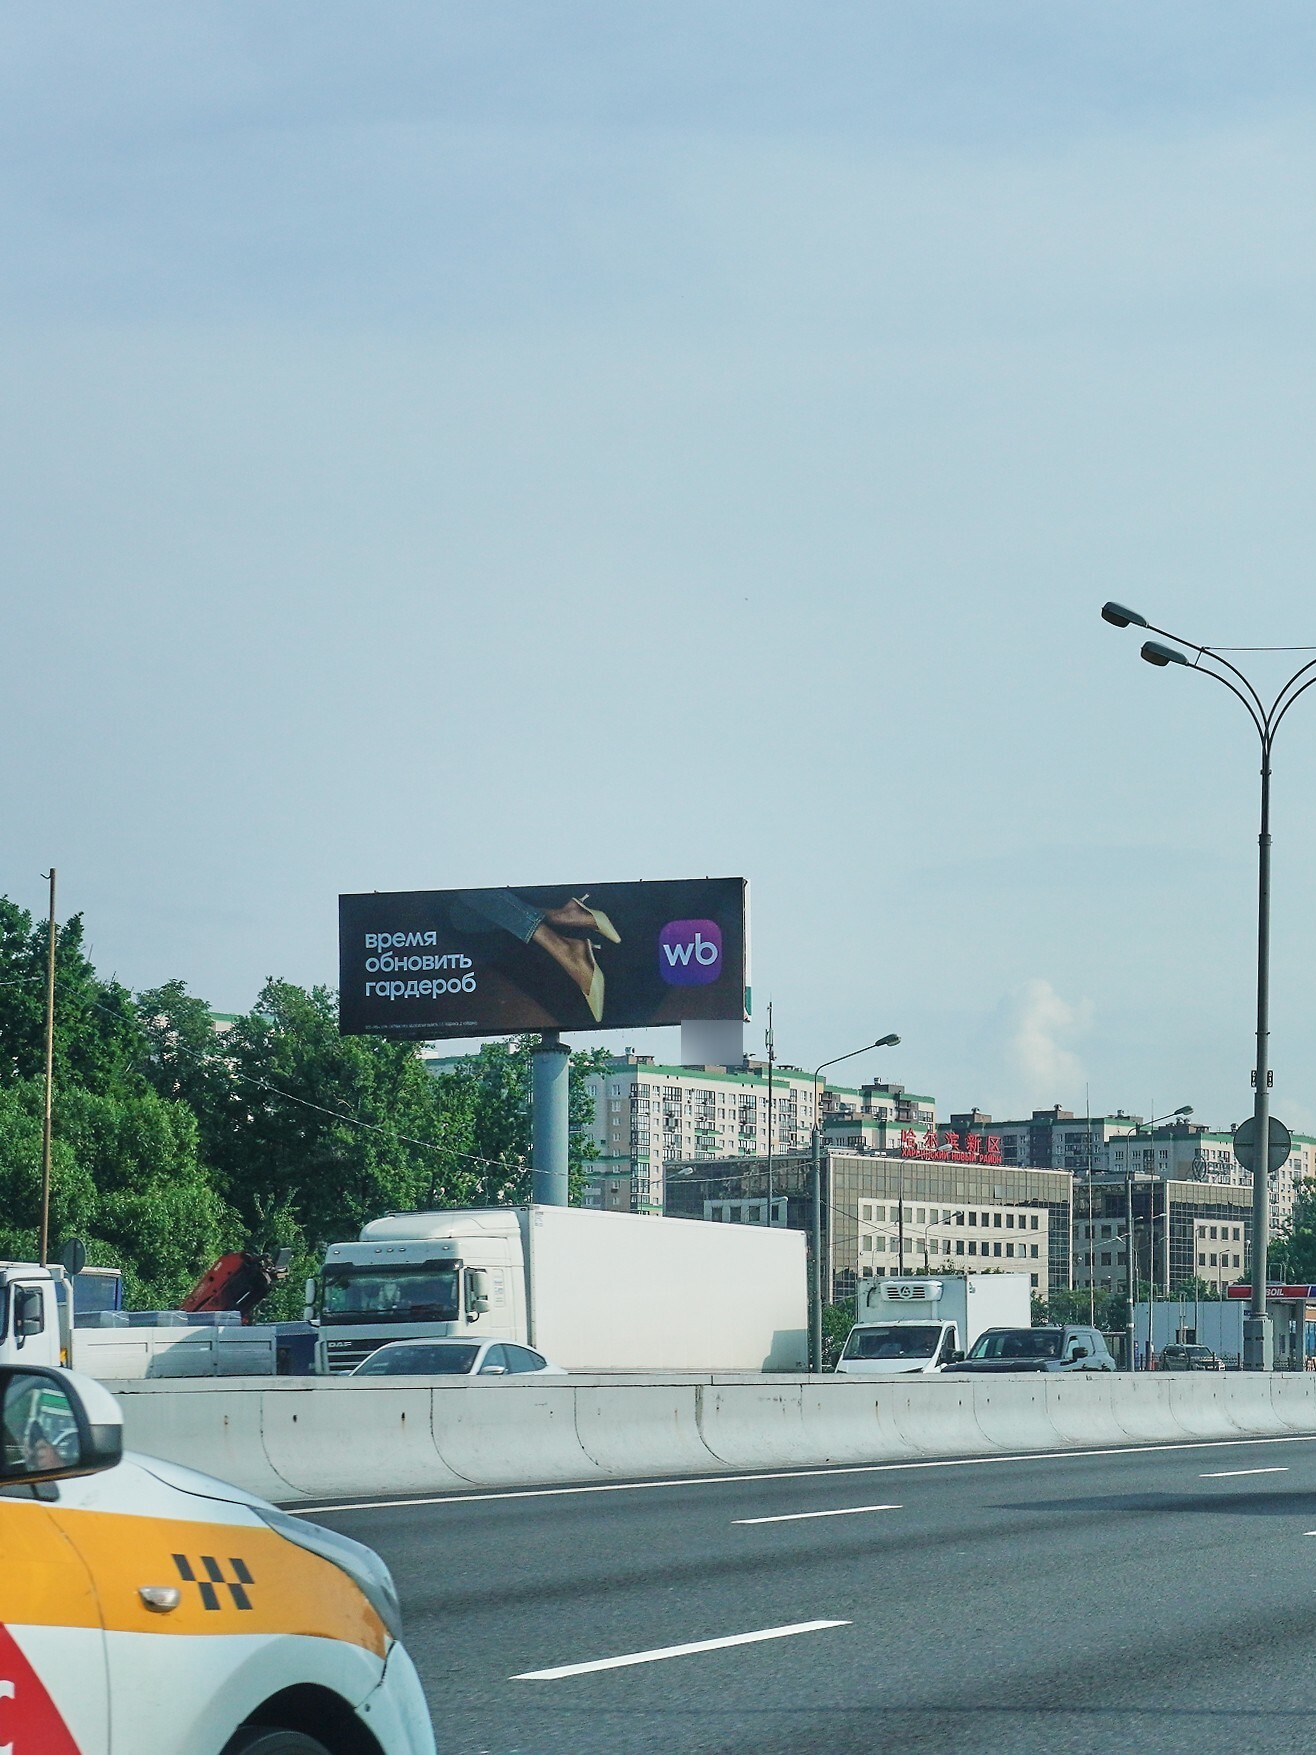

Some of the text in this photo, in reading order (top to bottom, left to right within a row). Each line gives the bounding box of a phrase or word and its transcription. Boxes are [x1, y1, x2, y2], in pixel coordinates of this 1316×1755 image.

[365, 930, 437, 953] время
[662, 932, 719, 966] wb
[365, 953, 472, 974] обновить
[365, 972, 477, 1000] гардероб
[980, 1152, 1002, 1164] РАЙОН
